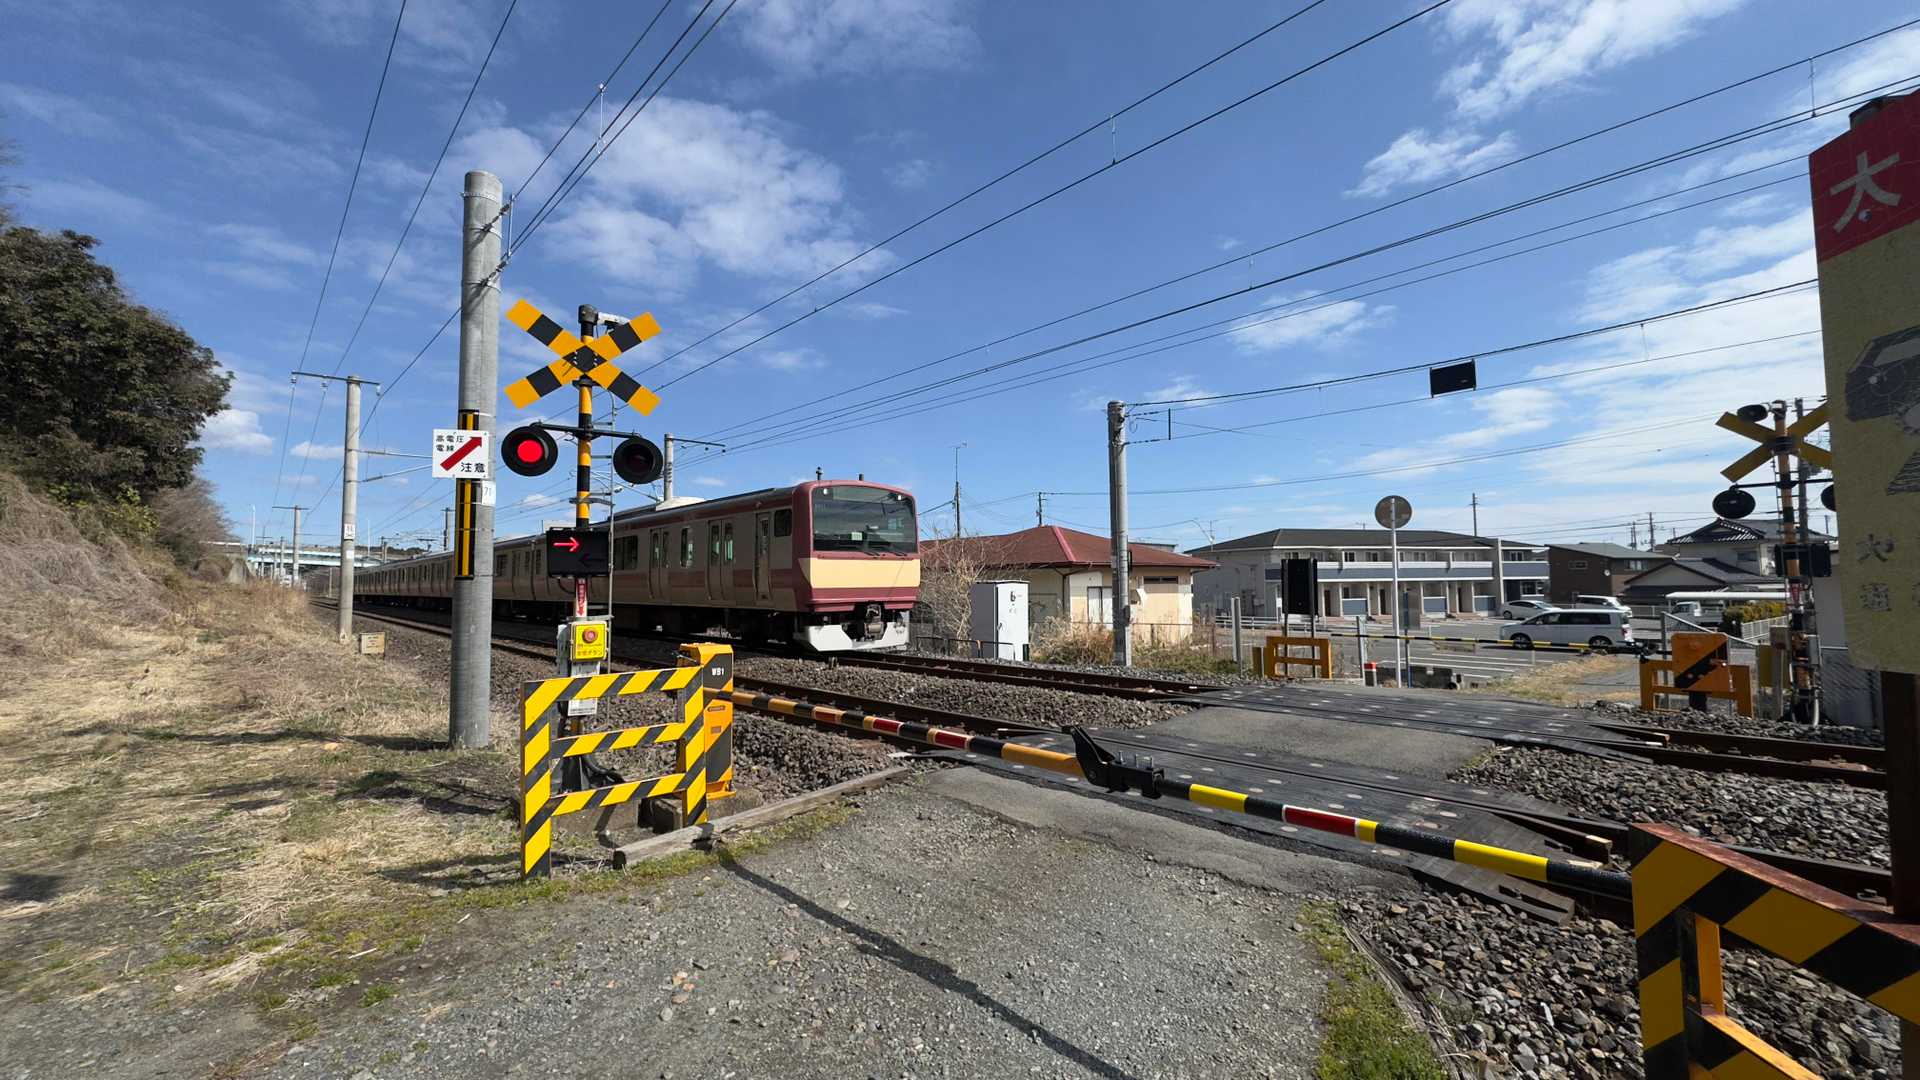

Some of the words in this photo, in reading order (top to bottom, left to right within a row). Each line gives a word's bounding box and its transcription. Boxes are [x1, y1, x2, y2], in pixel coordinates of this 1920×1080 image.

[1829, 150, 1902, 234] 大
[436, 435, 464, 443] 高電圧
[436, 444, 455, 452] 電線
[460, 461, 486, 473] 注意
